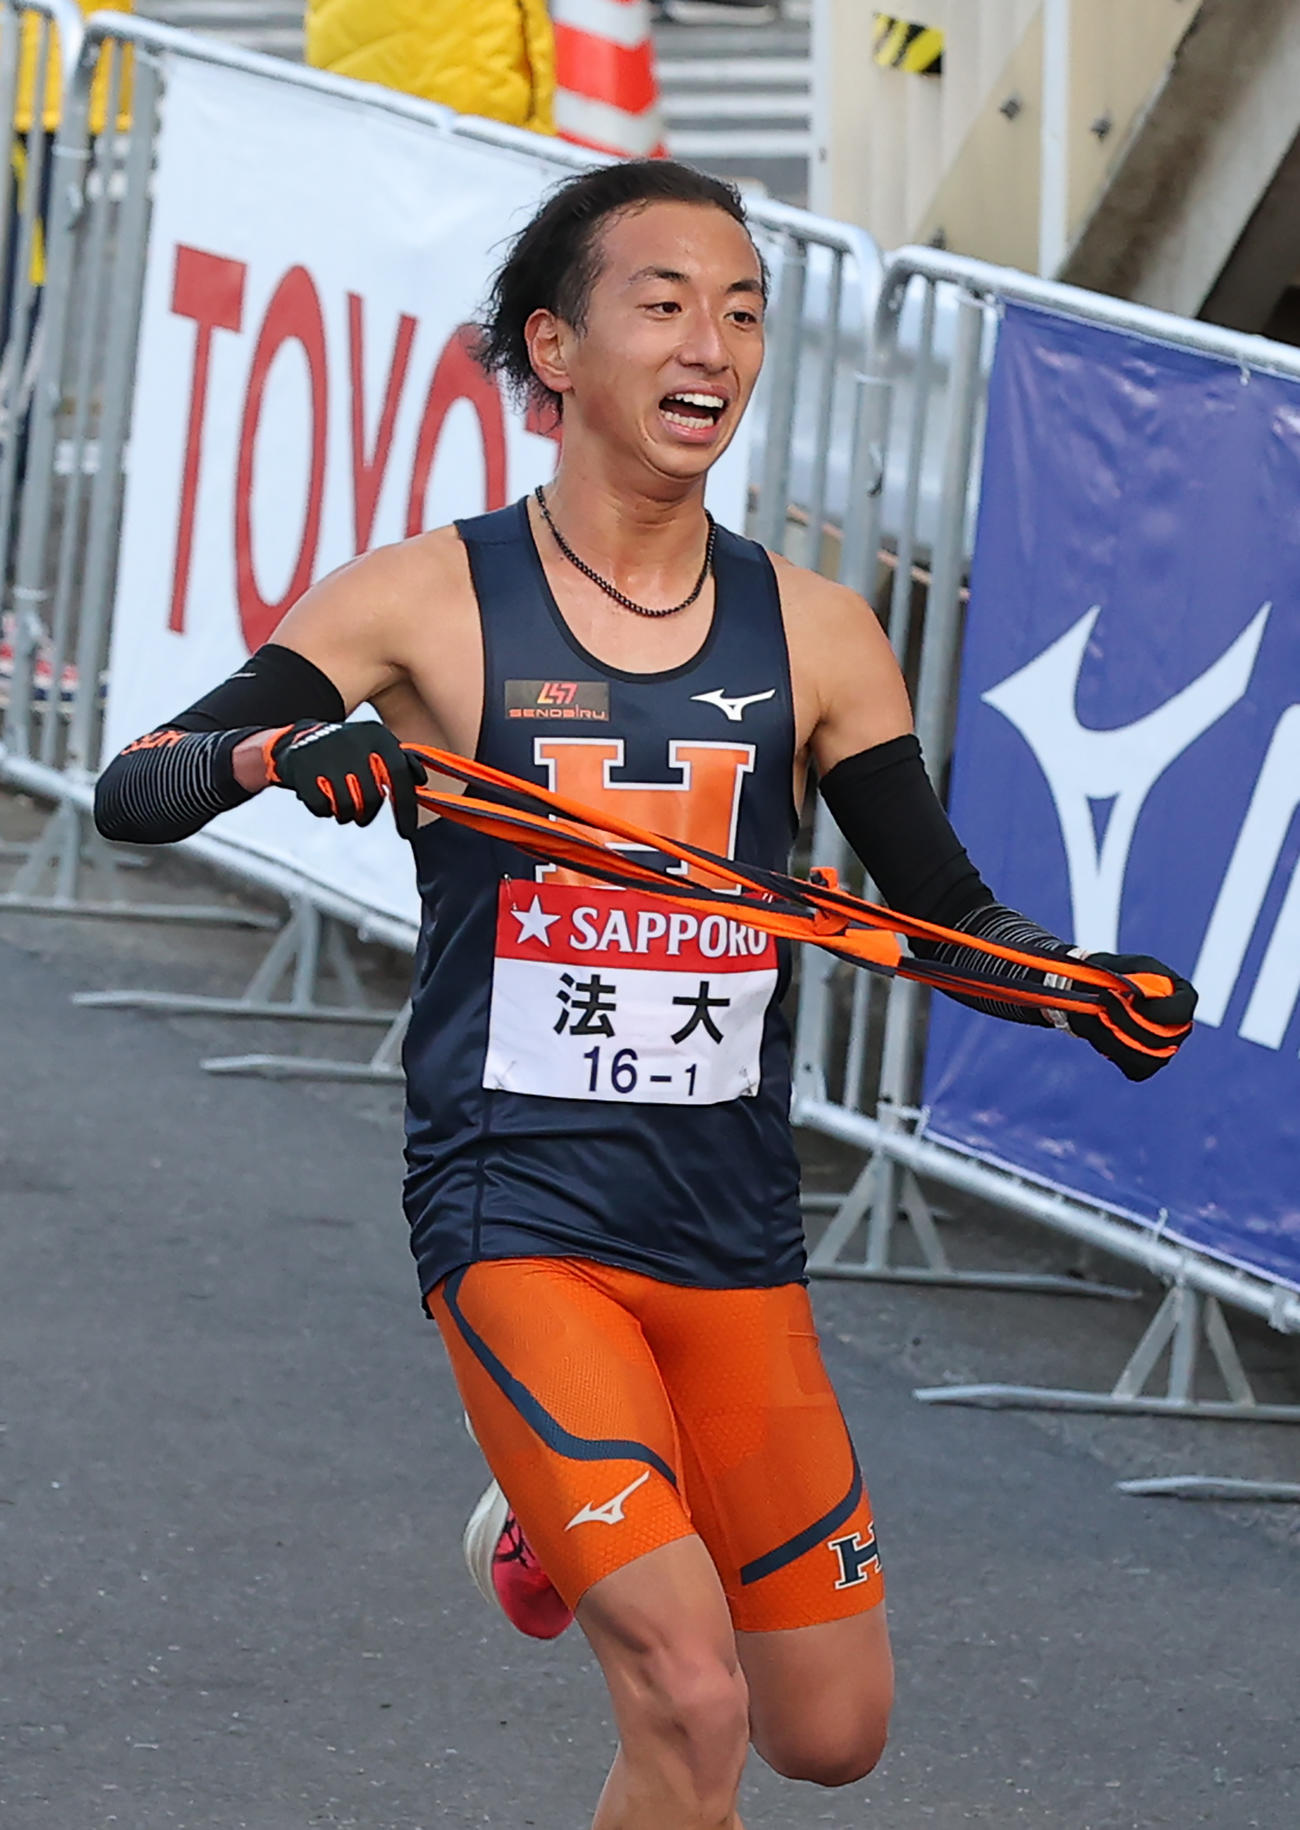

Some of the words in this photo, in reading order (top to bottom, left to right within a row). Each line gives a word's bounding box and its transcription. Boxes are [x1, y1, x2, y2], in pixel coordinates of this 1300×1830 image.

[534, 737, 756, 896] H
[569, 906, 768, 958] SAPPORO
[583, 1045, 697, 1096] 16-1
